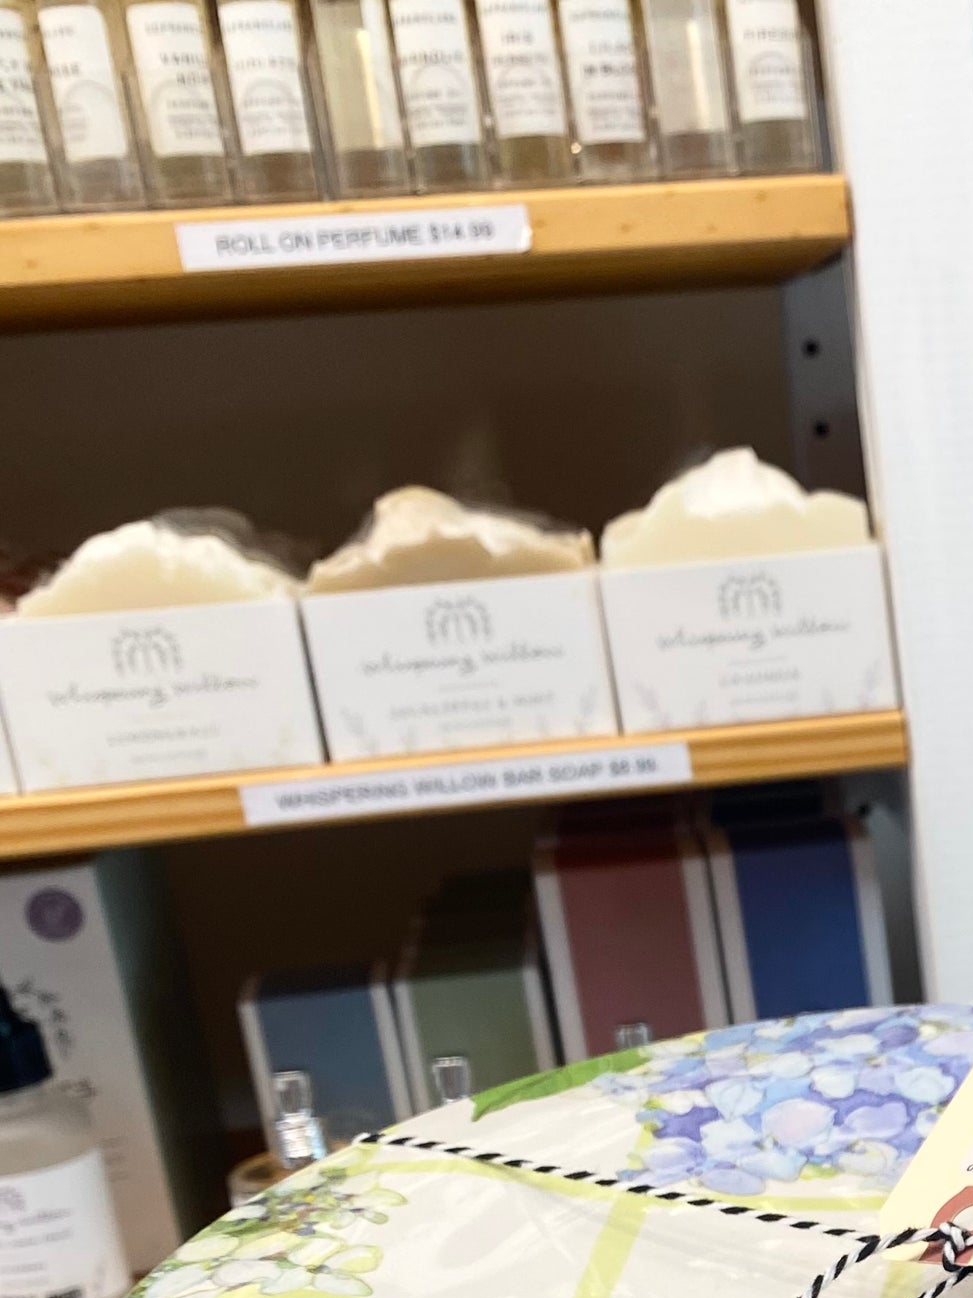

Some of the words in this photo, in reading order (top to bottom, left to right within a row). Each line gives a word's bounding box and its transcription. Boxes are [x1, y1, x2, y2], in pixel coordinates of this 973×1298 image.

[214, 233, 277, 256] ROLL
[279, 229, 313, 253] ON
[316, 224, 422, 249] PERFUME
[277, 782, 410, 810] WHISPERING
[413, 772, 497, 799] WILLOW
[501, 766, 543, 790] BAR
[548, 762, 603, 783] SOAP
